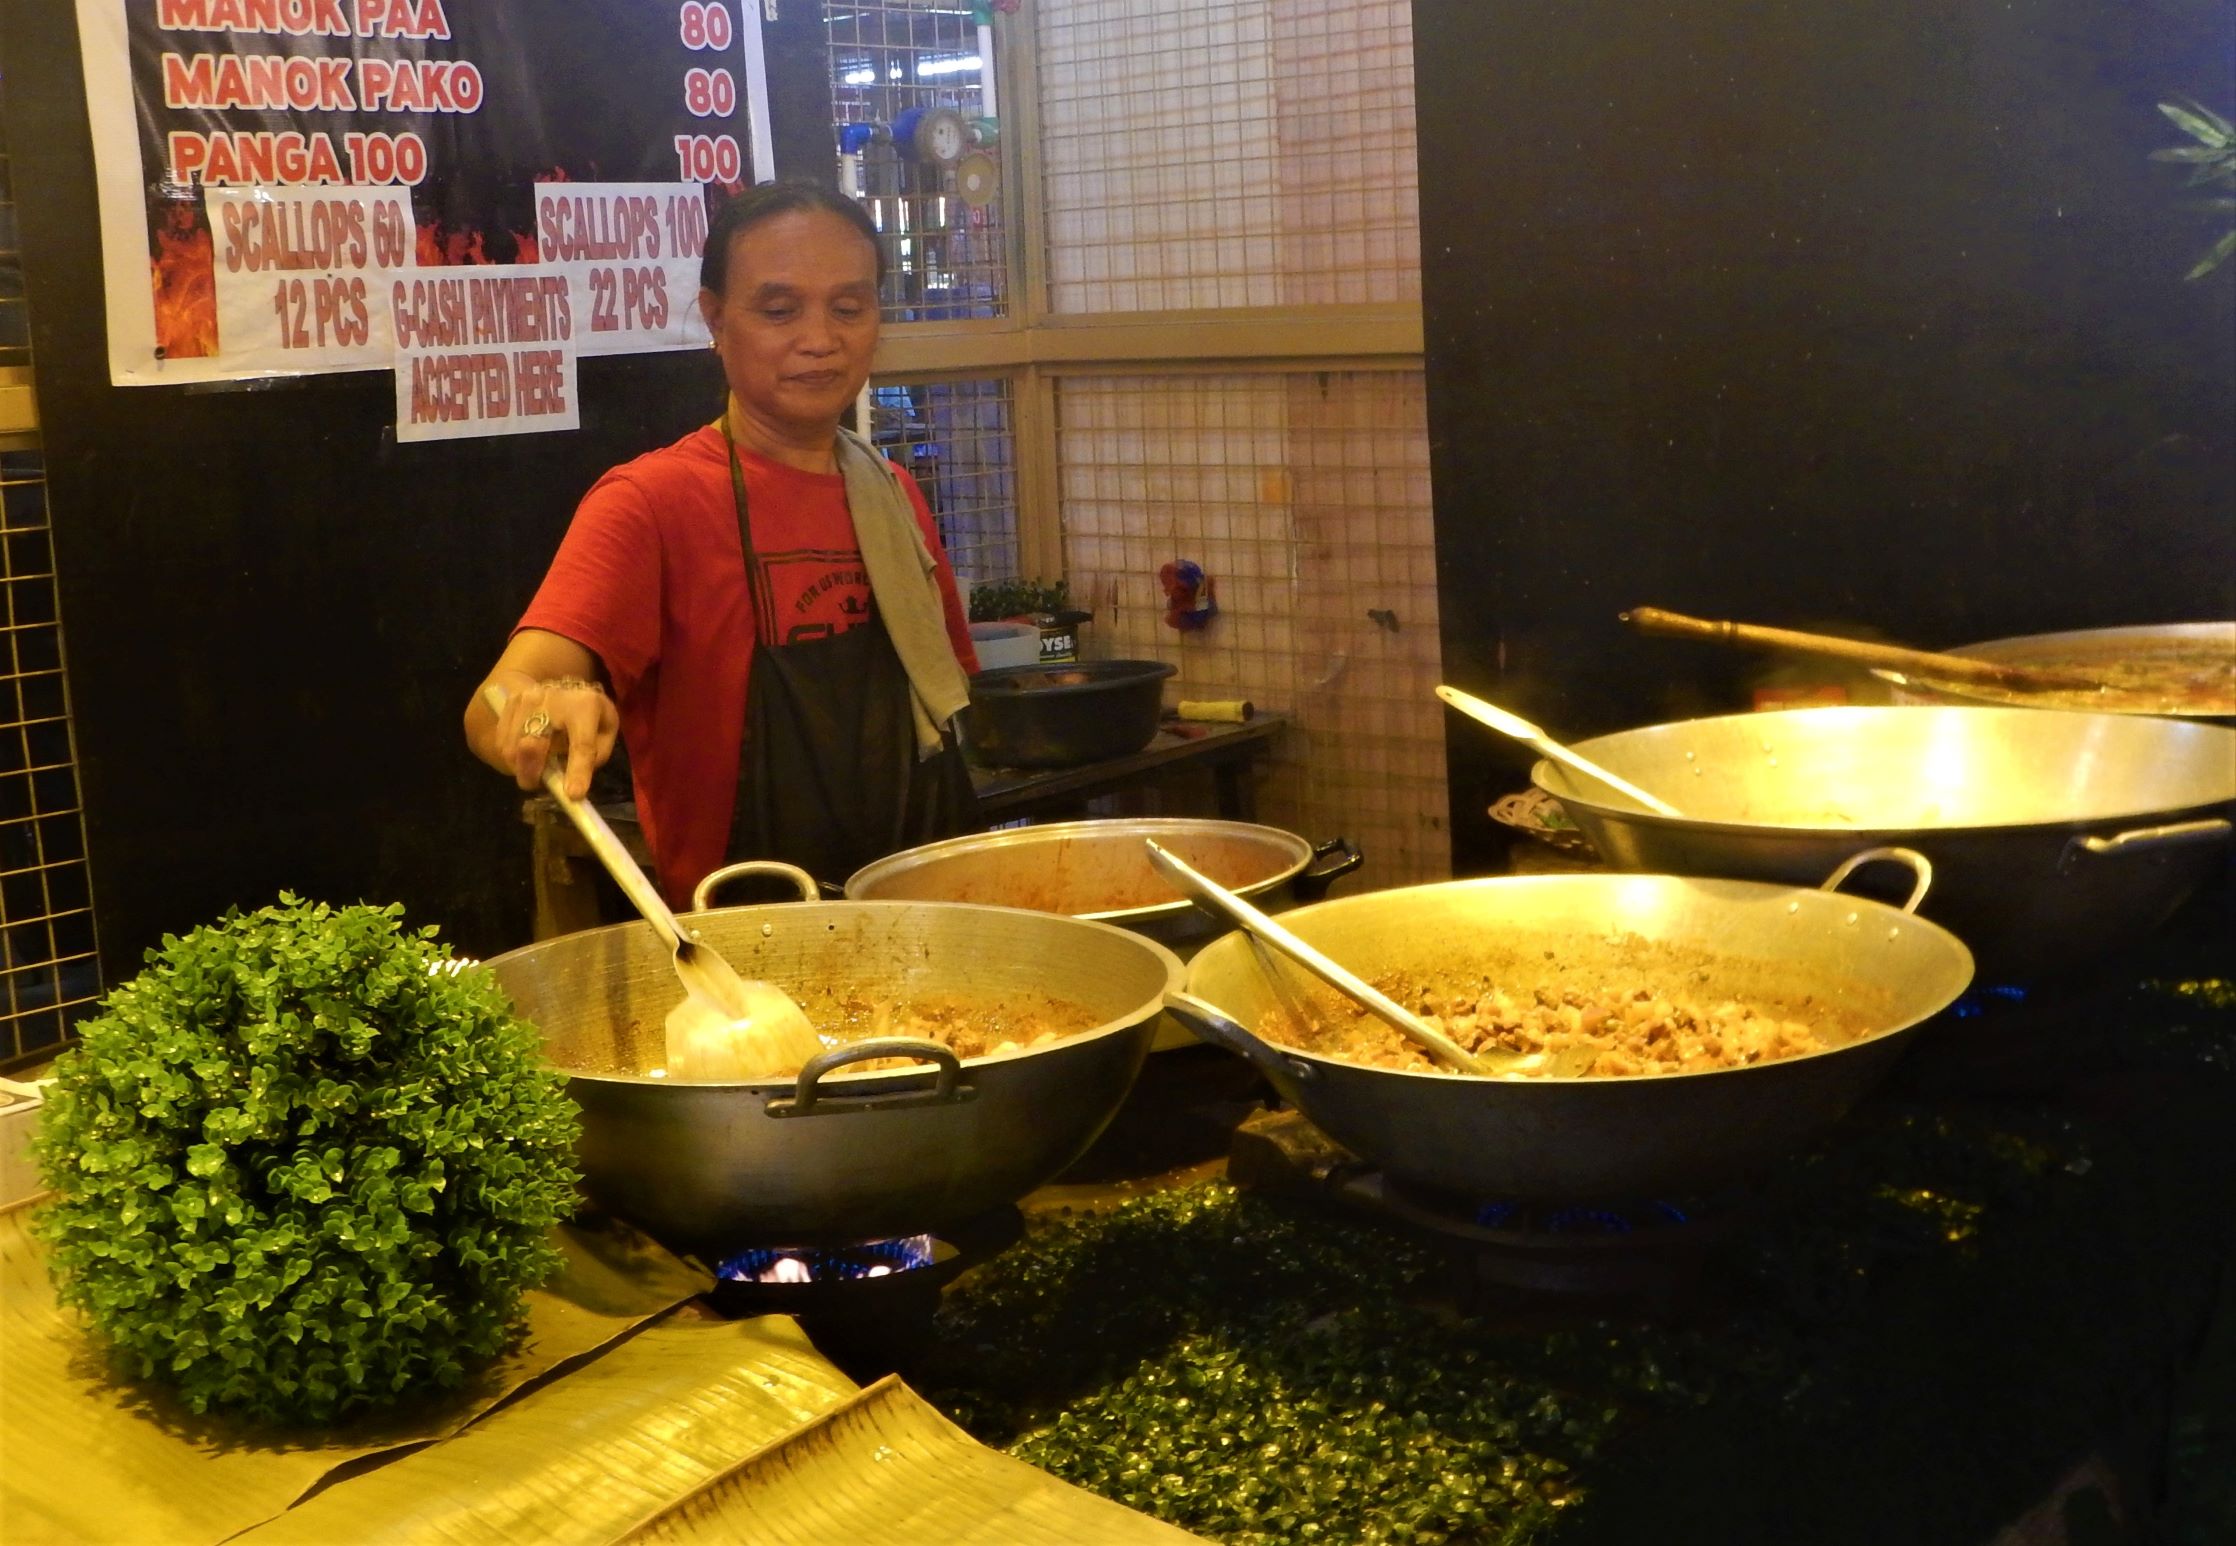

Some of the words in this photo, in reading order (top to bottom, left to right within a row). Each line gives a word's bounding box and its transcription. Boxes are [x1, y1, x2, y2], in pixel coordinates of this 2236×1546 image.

[158, 0, 350, 36] MANOK
[355, 0, 450, 39] PAA
[681, 1, 732, 51] 80
[162, 53, 357, 111] MANOK
[358, 58, 483, 113] PAKO
[685, 68, 735, 117] 80
[169, 131, 345, 186] PANGA
[344, 132, 427, 186] 100
[674, 135, 741, 183] 100
[222, 200, 367, 273] SCALLOPS
[373, 200, 405, 268] 60
[540, 196, 660, 262] SCALLOPS
[666, 196, 705, 258] 100
[275, 279, 309, 349] 12
[314, 277, 369, 347] PCS
[392, 279, 468, 349] G-CASH
[470, 275, 571, 345] PAYMENTS
[589, 268, 619, 331] 22
[622, 266, 668, 330] PCS
[411, 352, 510, 424] ACCEPTED
[513, 350, 565, 417] HERE
[1040, 635, 1076, 652] YSE
